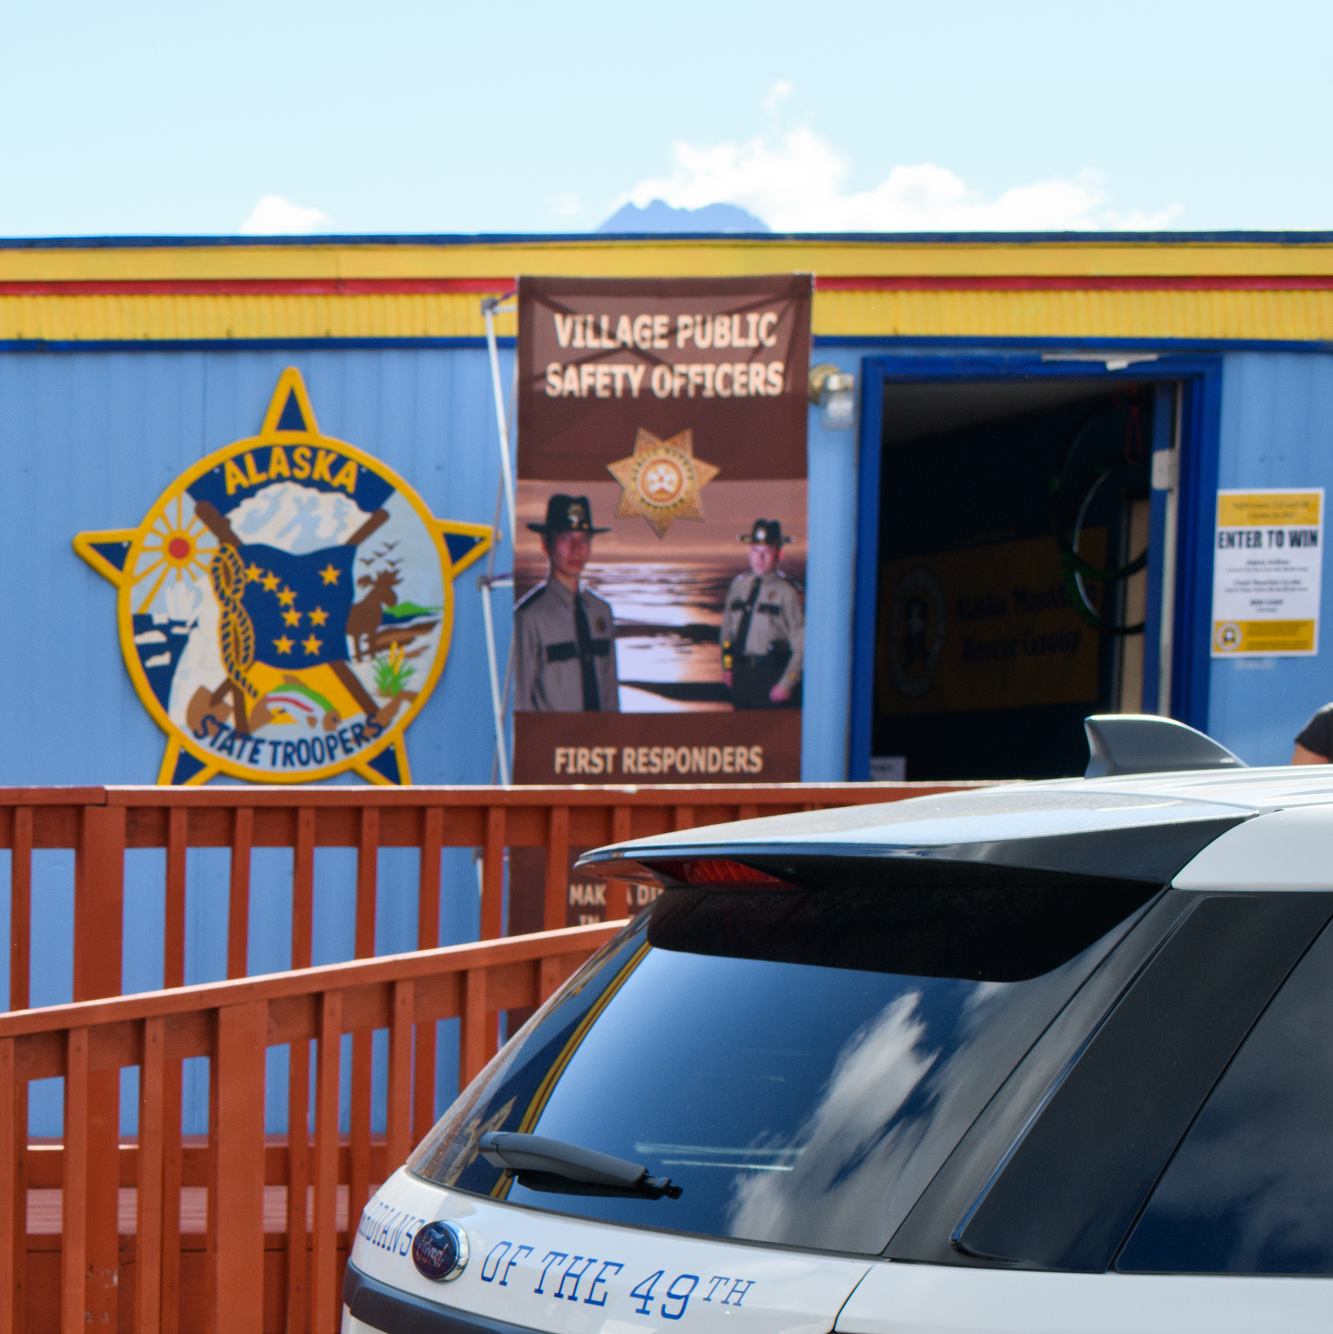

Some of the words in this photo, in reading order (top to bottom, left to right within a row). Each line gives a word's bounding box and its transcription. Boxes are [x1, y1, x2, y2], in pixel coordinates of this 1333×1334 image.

[553, 312, 671, 350] VILLAGE
[676, 311, 779, 350] PUBLIC
[544, 361, 647, 399] SAFETY
[650, 360, 785, 399] OFFICERS
[223, 445, 359, 496] ALASKA
[1217, 530, 1263, 549] ENTER
[1266, 530, 1285, 548] TO
[1288, 529, 1319, 548] WIN
[193, 714, 266, 764] STATE
[269, 713, 384, 767] TROOPERS
[553, 746, 618, 775] FIRST
[622, 744, 764, 775] RESPONDERS
[481, 1240, 536, 1288] OF
[535, 1250, 626, 1308] THE
